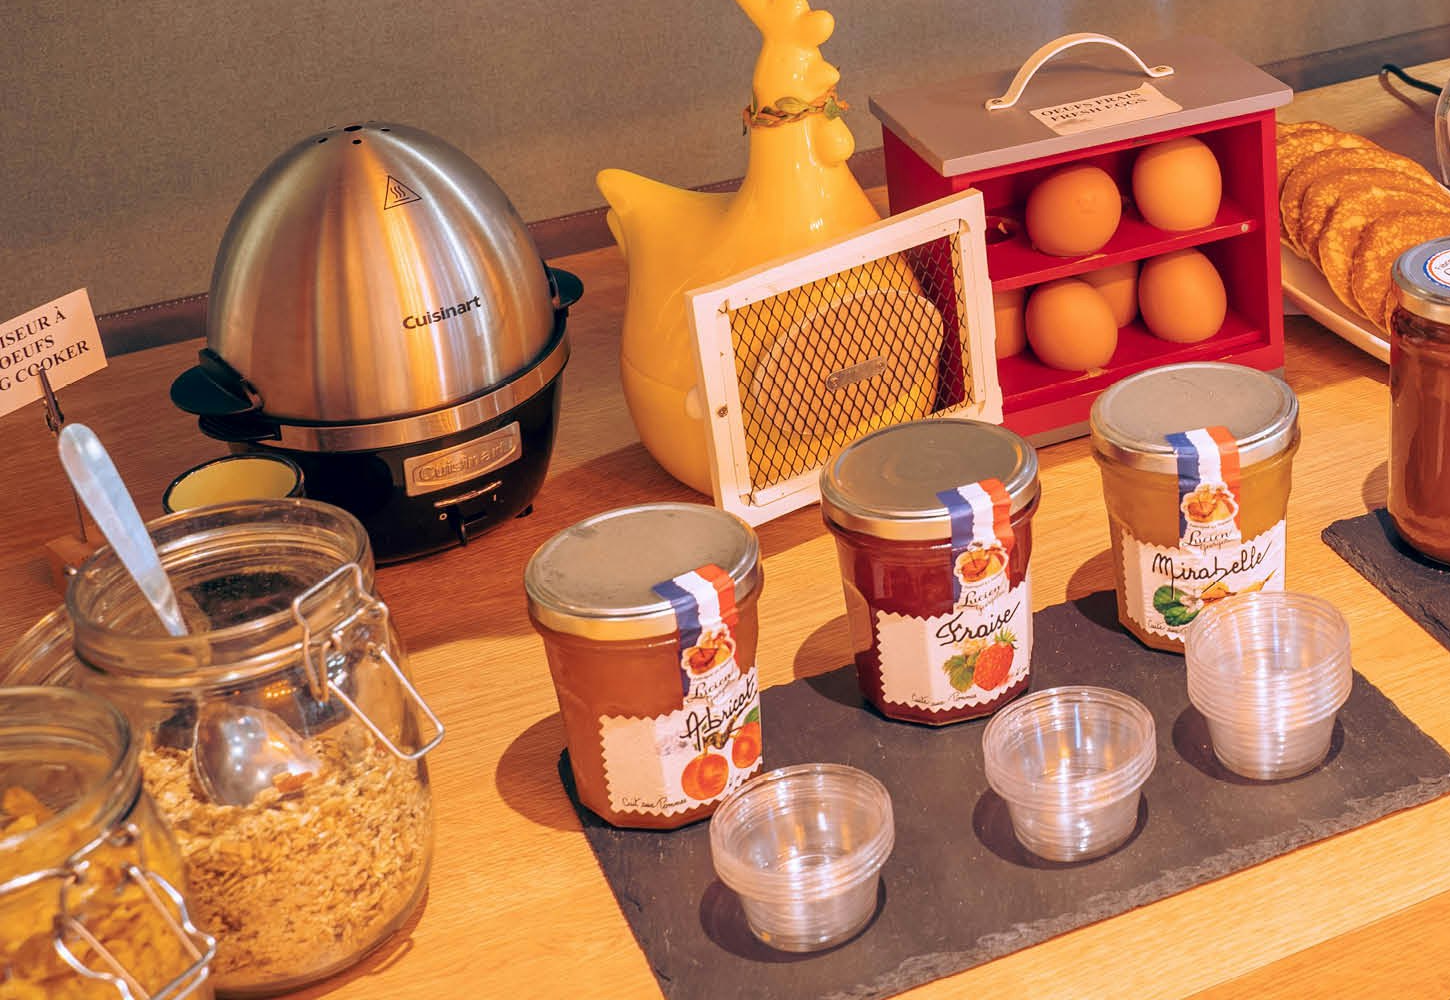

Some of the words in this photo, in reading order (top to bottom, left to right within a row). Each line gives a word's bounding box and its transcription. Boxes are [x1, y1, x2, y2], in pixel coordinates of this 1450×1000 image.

[54, 305, 67, 324] À
[402, 295, 481, 330] Cuisinart
[15, 340, 90, 383] COOKER
[420, 437, 513, 481] Cuisinart
[1152, 541, 1273, 600] Mirabelle
[936, 601, 1020, 647] Fraise
[680, 674, 758, 752] Abricot
